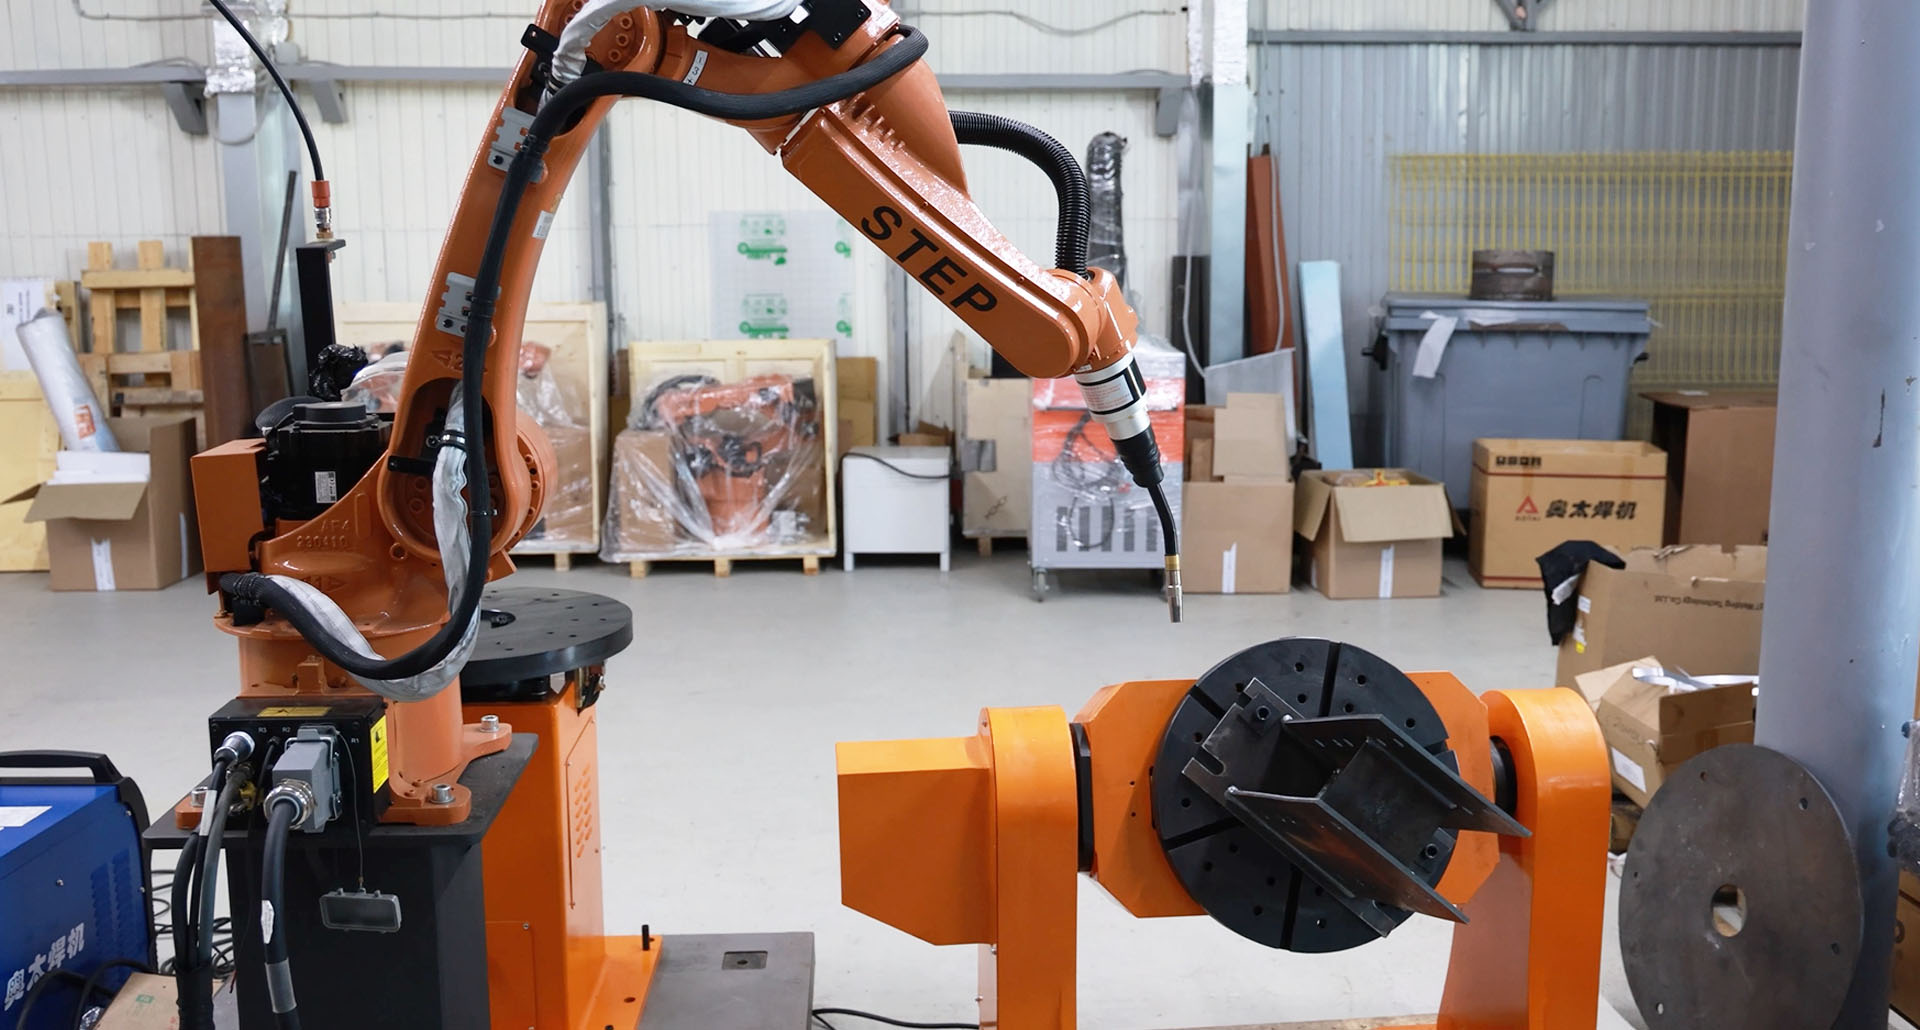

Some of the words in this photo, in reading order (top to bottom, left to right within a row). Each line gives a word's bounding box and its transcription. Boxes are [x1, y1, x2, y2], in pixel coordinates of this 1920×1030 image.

[861, 206, 998, 312] STEP
[1545, 500, 1637, 521] 奥太焊机
[4, 922, 85, 1011] 奥太焊机
